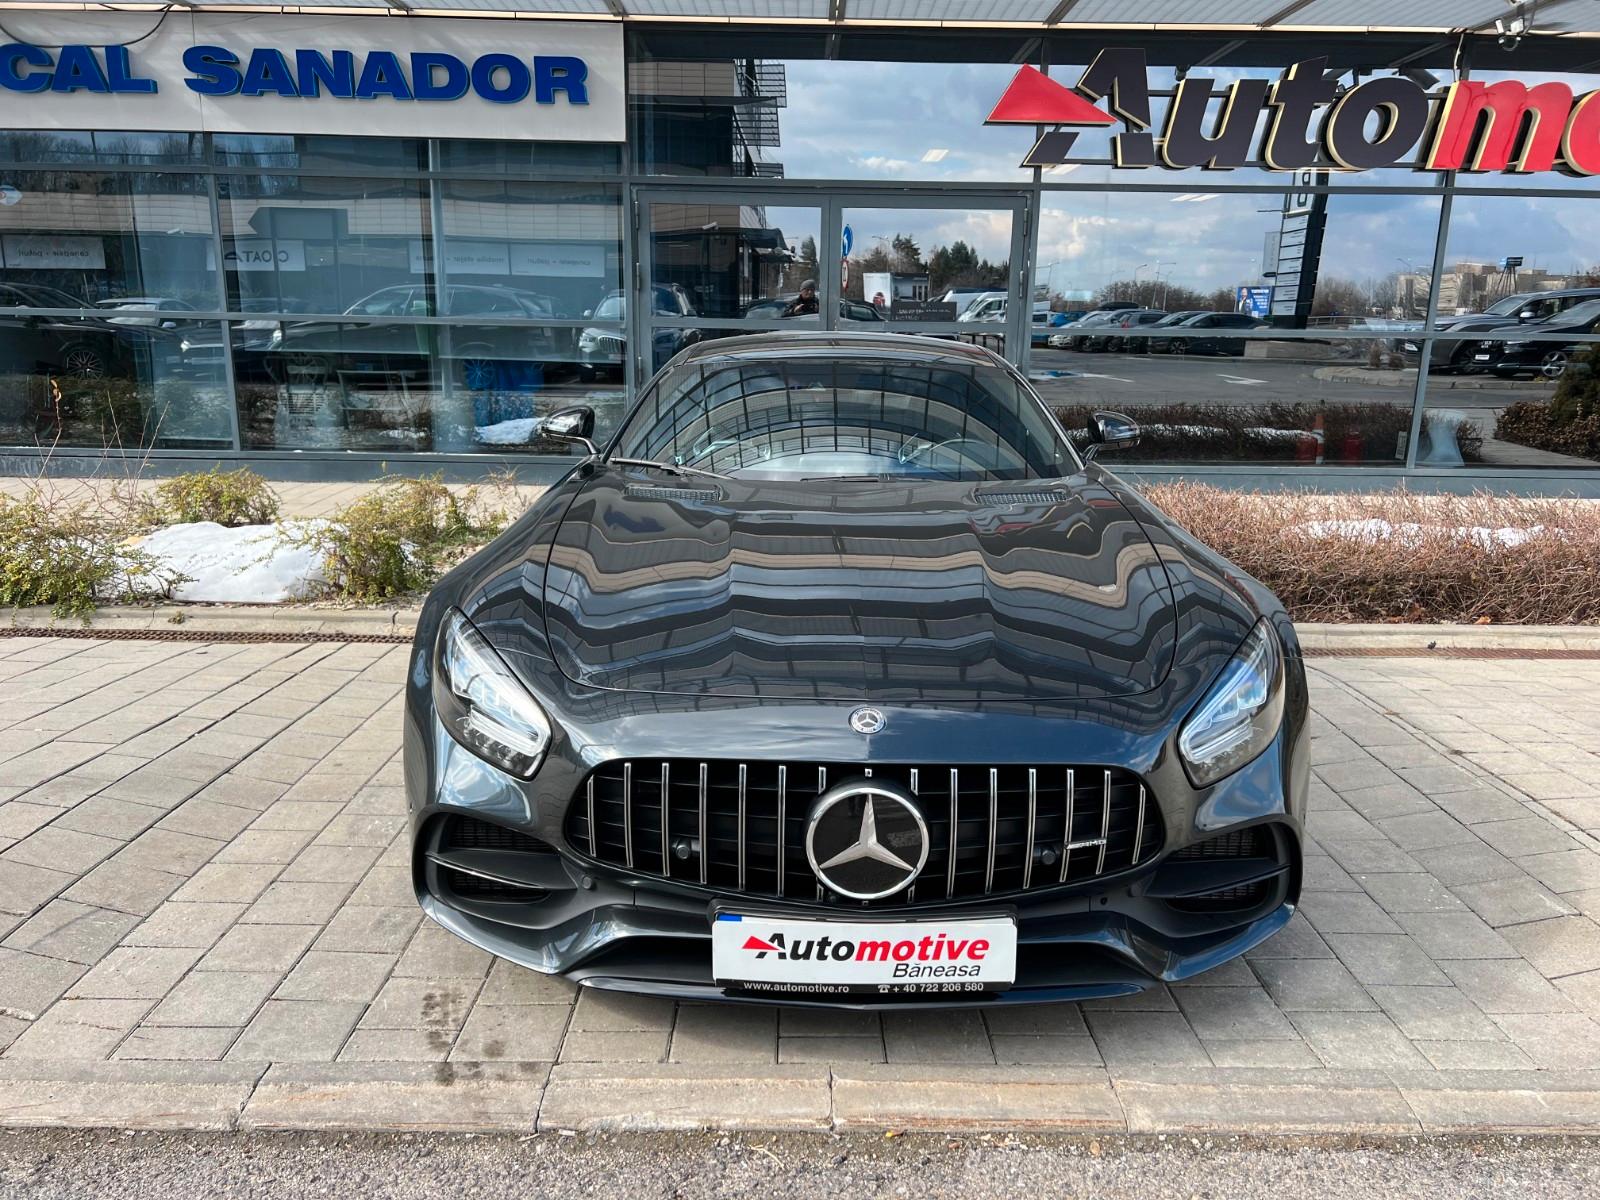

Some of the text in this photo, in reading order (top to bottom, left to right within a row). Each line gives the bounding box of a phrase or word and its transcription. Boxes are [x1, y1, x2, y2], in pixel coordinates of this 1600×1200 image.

[182, 45, 590, 105] SANADOR
[742, 932, 990, 962] Automotive
[893, 963, 982, 978] Băneasa
[743, 981, 850, 994] www.automotive.ro
[902, 983, 917, 993] 40
[919, 983, 940, 993] 722
[942, 982, 962, 993] 206
[965, 982, 984, 992] 580
